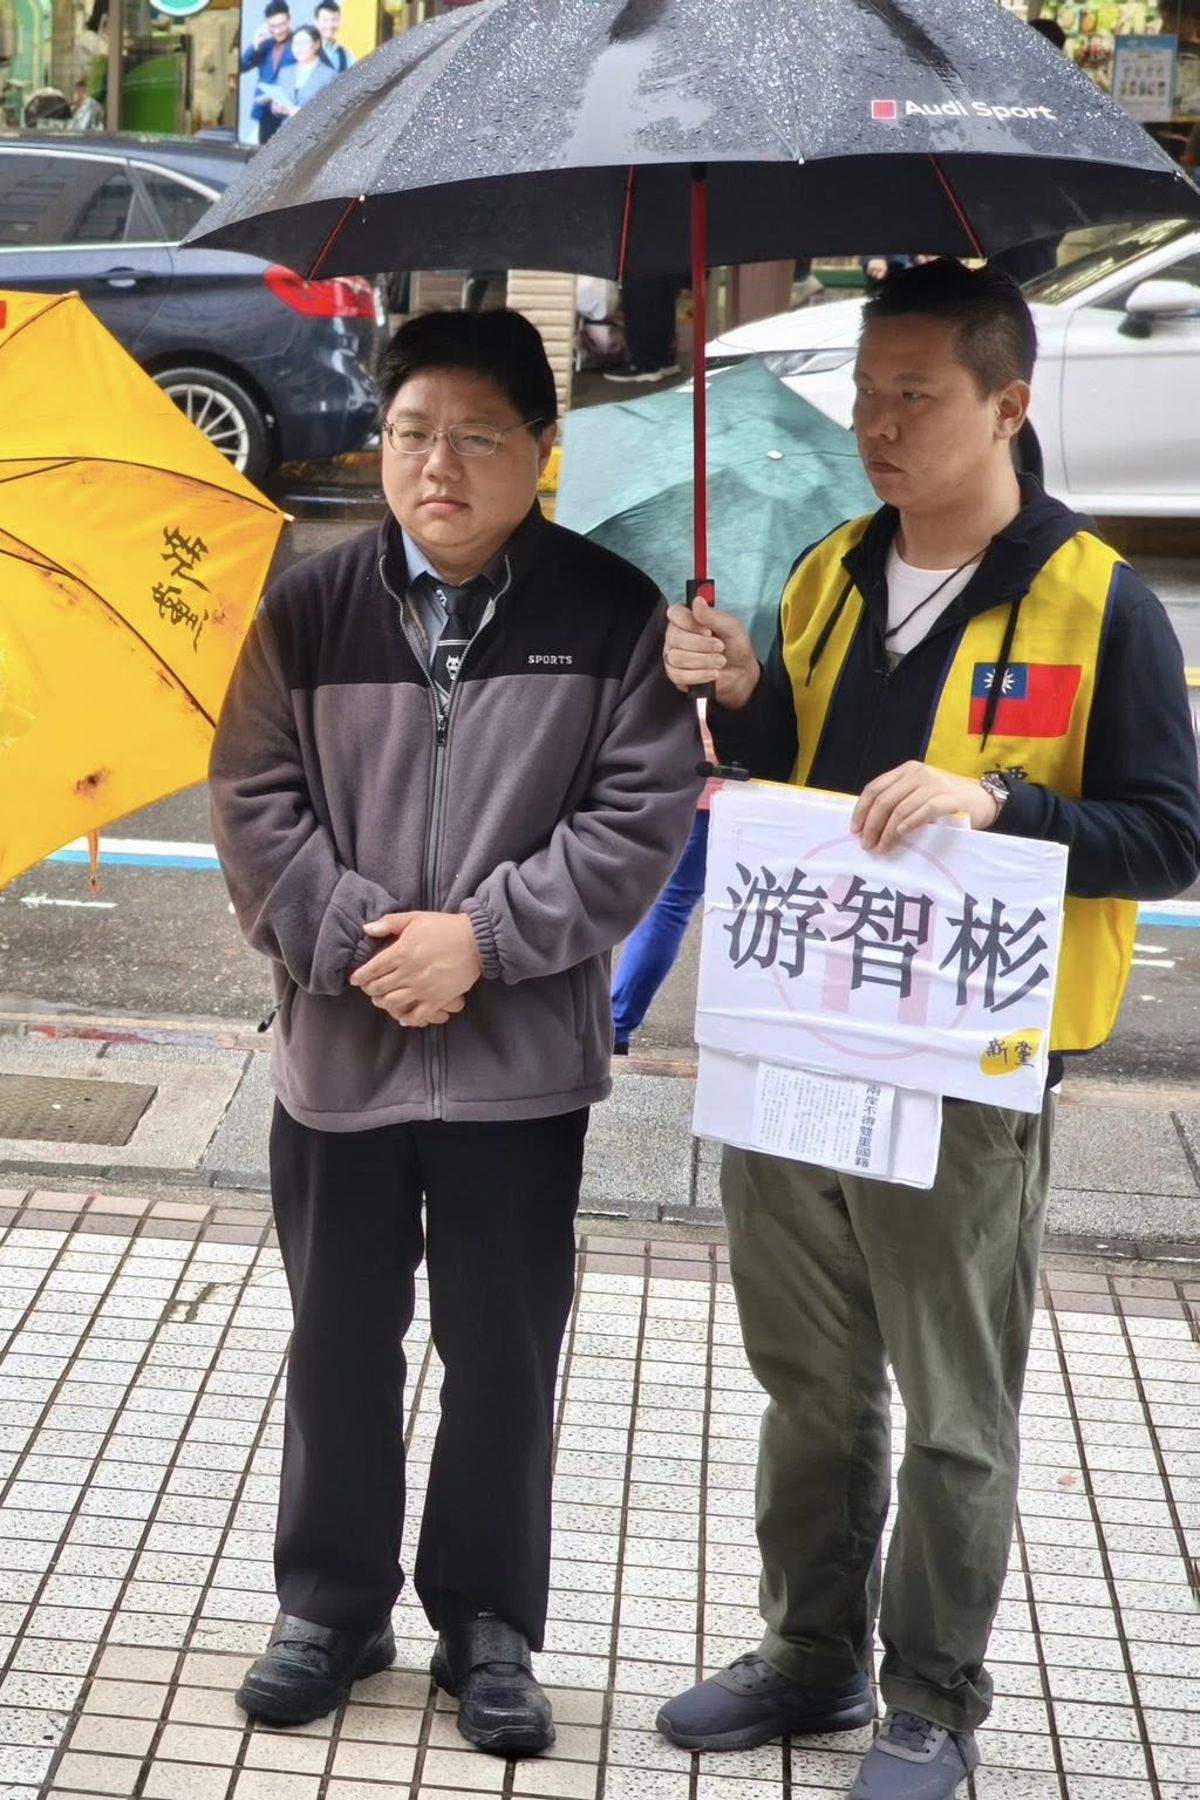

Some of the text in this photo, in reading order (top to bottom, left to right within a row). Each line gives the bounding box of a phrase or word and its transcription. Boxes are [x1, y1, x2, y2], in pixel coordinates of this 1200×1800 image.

[905, 100, 1057, 121] Audi Sport
[528, 654, 573, 665] SPORTS
[722, 861, 1051, 1014] 游智彬
[985, 1036, 1036, 1068] 新黨
